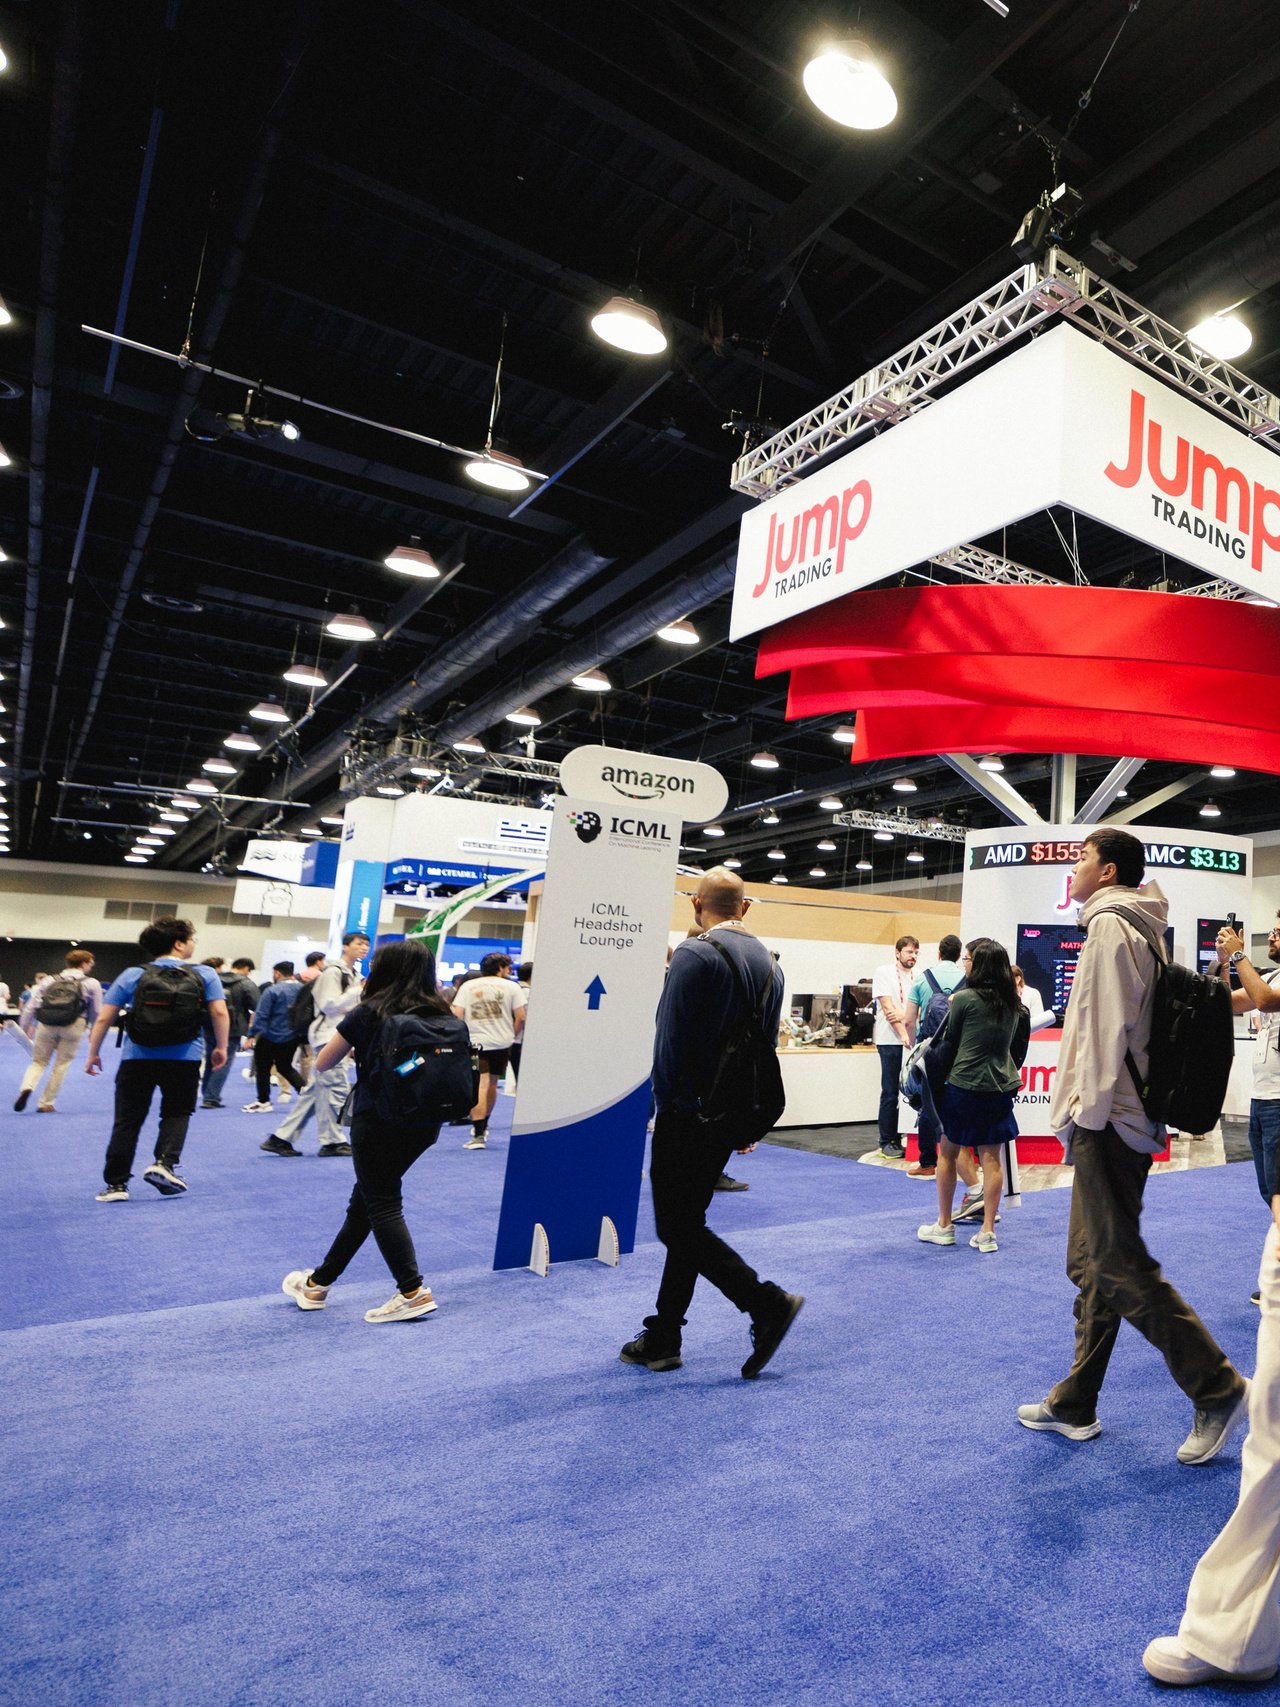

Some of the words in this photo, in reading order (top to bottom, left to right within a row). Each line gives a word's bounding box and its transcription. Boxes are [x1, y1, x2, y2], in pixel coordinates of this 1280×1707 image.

[1151, 494, 1246, 559] TRADING
[752, 479, 872, 598] Jump
[775, 558, 832, 598] TRADING
[601, 766, 695, 794] amazon
[610, 817, 671, 840] ICML
[984, 844, 1027, 865] AMD
[1190, 847, 1240, 871] $3.13
[591, 902, 630, 917] ICML
[573, 917, 643, 933] Headshot
[1023, 929, 1041, 937] Jump
[580, 933, 634, 950] Lounge
[1018, 1066, 1057, 1092] um
[1014, 1095, 1051, 1104] RADIN
